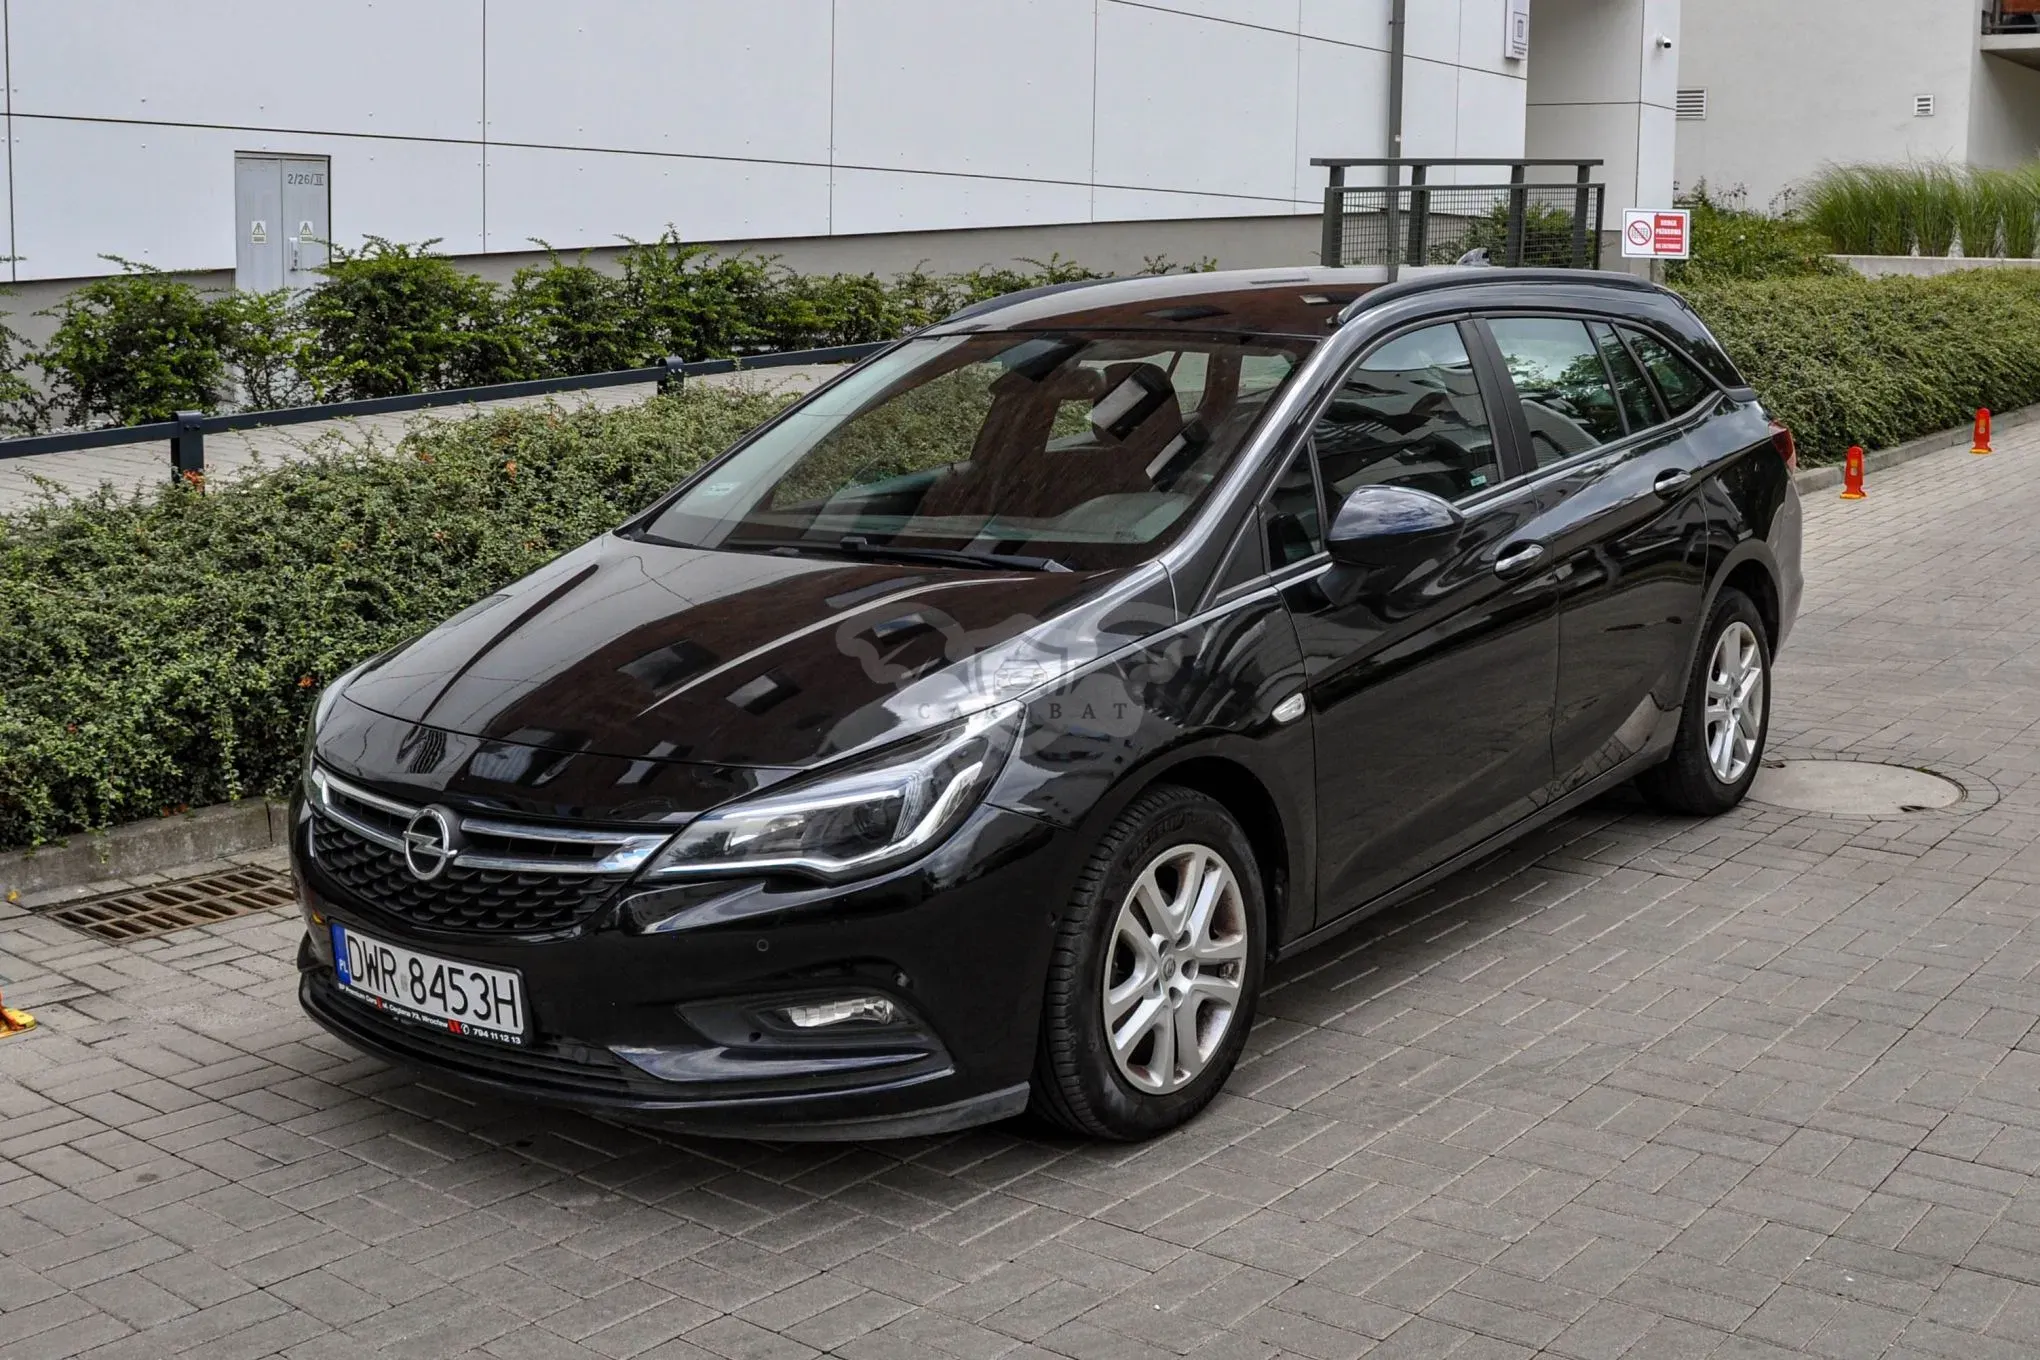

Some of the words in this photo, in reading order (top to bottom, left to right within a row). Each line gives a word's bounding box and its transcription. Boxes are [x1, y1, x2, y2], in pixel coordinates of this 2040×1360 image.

[339, 959, 349, 973] PL
[347, 935, 399, 998] DWR
[409, 957, 518, 1028] 8453H
[490, 1032, 498, 1040] 11
[500, 1034, 510, 1042] 12
[511, 1036, 521, 1045] 13
